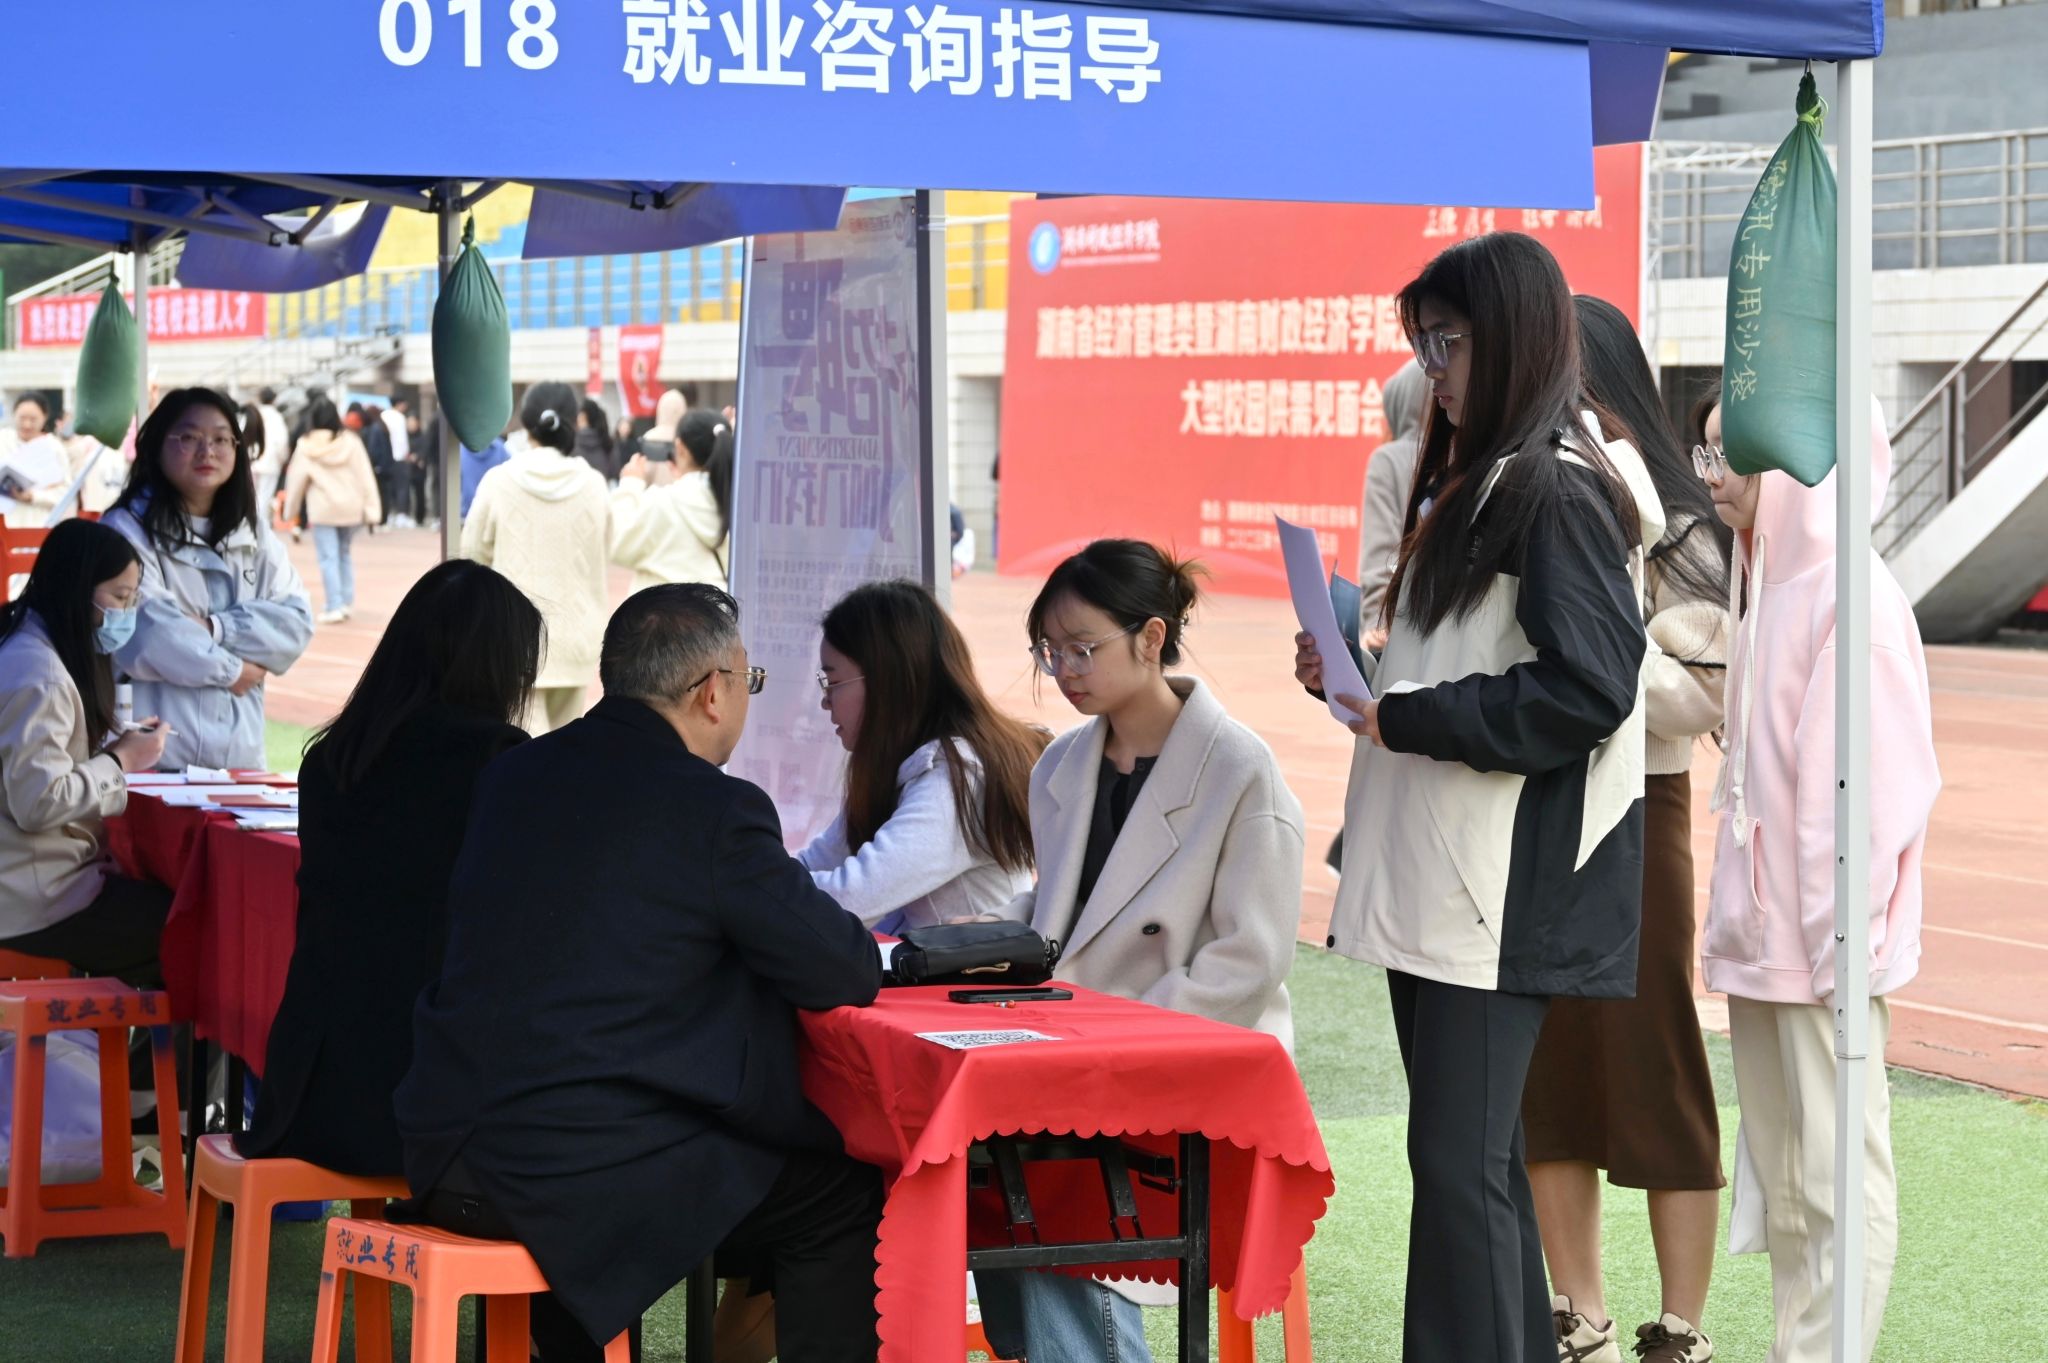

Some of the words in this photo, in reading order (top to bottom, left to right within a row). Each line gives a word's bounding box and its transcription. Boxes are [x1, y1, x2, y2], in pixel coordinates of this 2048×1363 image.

[377, 0, 561, 70] 018
[622, 0, 1163, 104] 就业咨询指导
[336, 1227, 421, 1280] 就业专用
